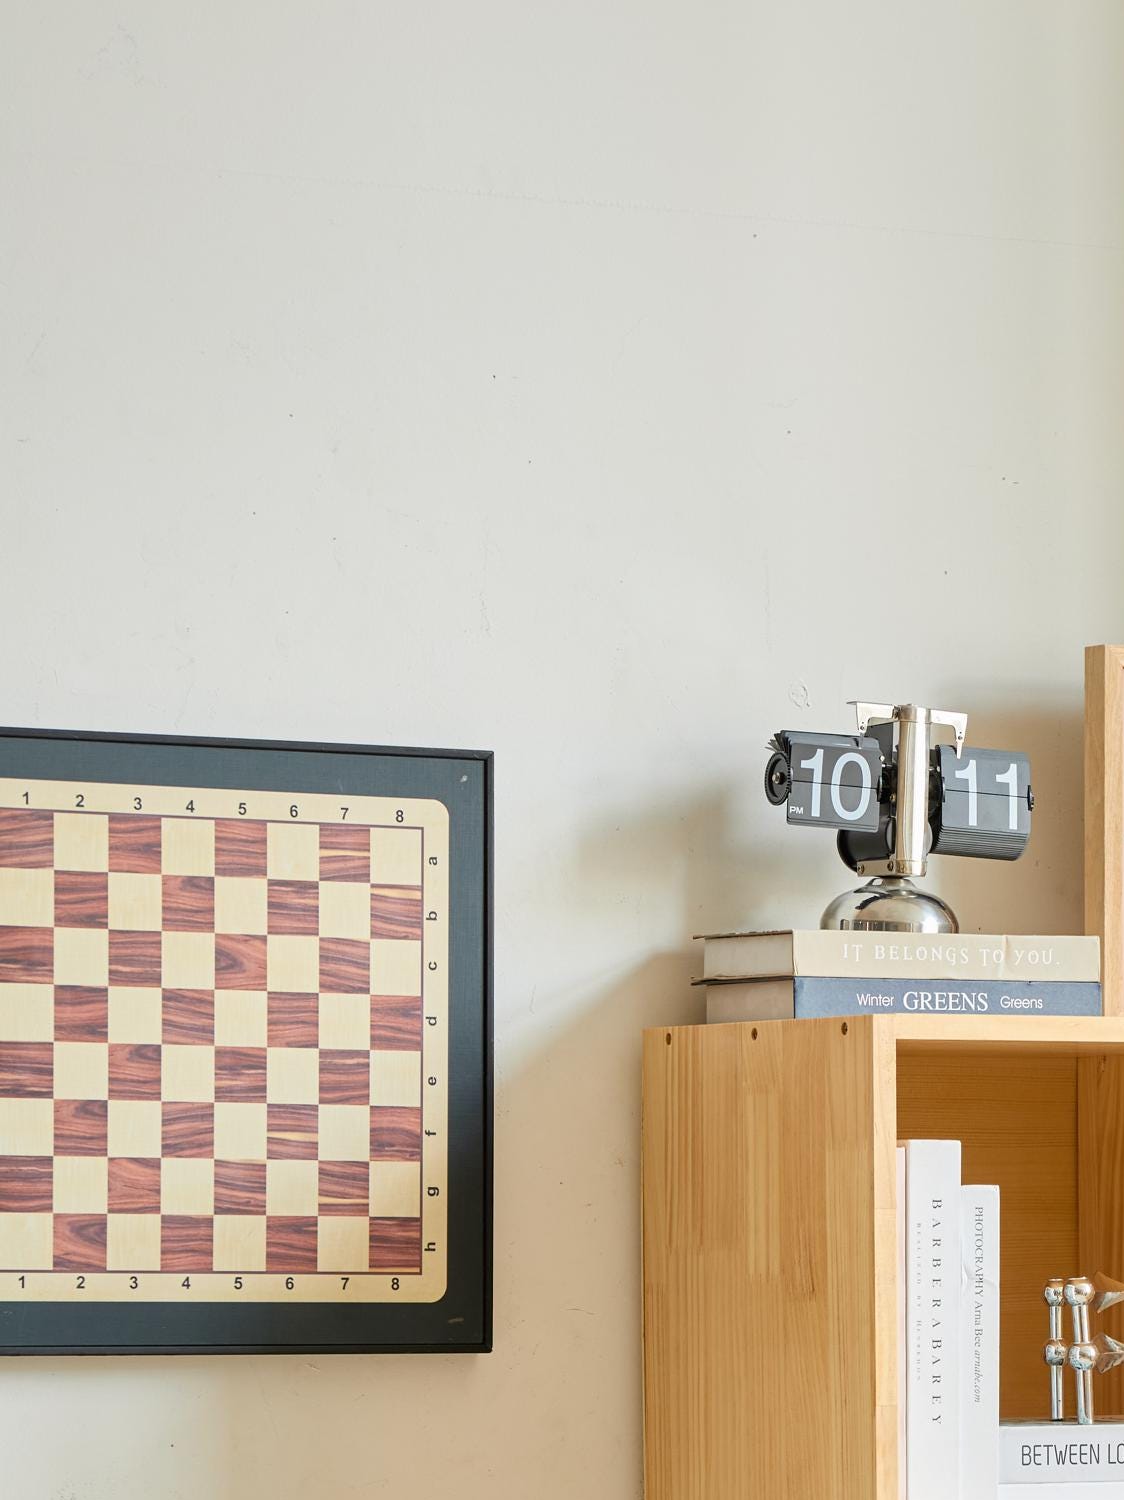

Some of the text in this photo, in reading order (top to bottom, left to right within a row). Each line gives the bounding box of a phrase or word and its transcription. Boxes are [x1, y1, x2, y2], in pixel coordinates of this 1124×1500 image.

[801, 749, 1018, 830] 10 11
[23, 792, 403, 822] 1 2 3 4 5 6 7 8
[789, 806, 804, 816] PM
[429, 857, 437, 865] a
[426, 911, 437, 920] b
[844, 944, 862, 961] IT
[875, 945, 968, 966] BELONGS
[979, 947, 1005, 966] TO
[429, 962, 437, 970] c
[857, 992, 1043, 1011] Winter GREENS Greens
[426, 1017, 437, 1026] d
[428, 1077, 436, 1085] e
[428, 1187, 439, 1196] g
[424, 1242, 435, 1251] h
[19, 1276, 399, 1290] 1 2 3 4 5 6 7 8
[973, 1301, 984, 1326] Arna
[973, 1329, 984, 1348] Bee
[1022, 1444, 1099, 1465] BETWEEN
